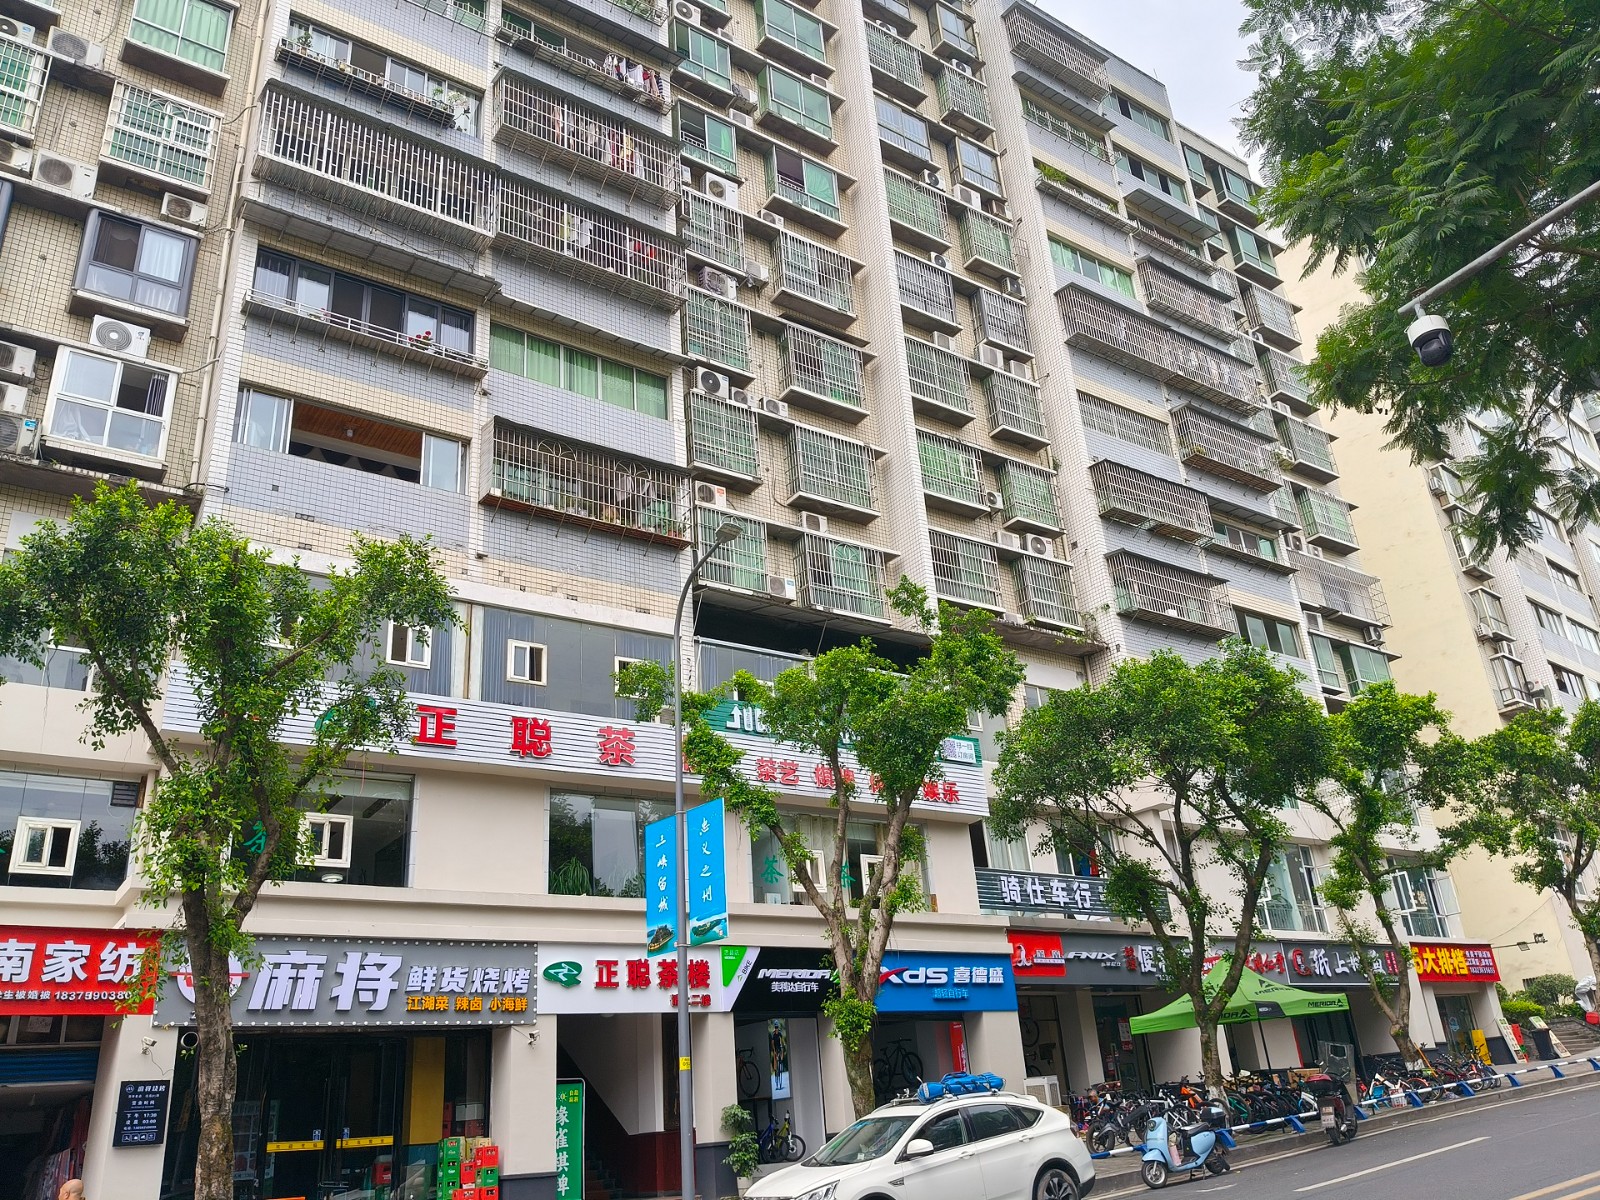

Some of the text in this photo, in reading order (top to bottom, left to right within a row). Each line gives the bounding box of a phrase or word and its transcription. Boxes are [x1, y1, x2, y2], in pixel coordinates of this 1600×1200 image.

[756, 757, 800, 786] 茶艺
[922, 778, 960, 803] 娱乐
[761, 855, 784, 884] 茶
[1000, 876, 1092, 909] 骑仕车行
[0, 938, 146, 983] 南家纺
[742, 960, 753, 975] BIKE
[1064, 951, 1117, 960] FNIX
[248, 950, 403, 1011] 麻将
[405, 965, 531, 994] 鲜货烧烤
[595, 959, 711, 990] 正聪茶楼
[757, 968, 832, 979] MERIDA
[953, 967, 1005, 984] 喜德盛
[0, 990, 50, 1000] 生被婚被
[406, 995, 528, 1012] 江湖菜 辣卤 小海鲜
